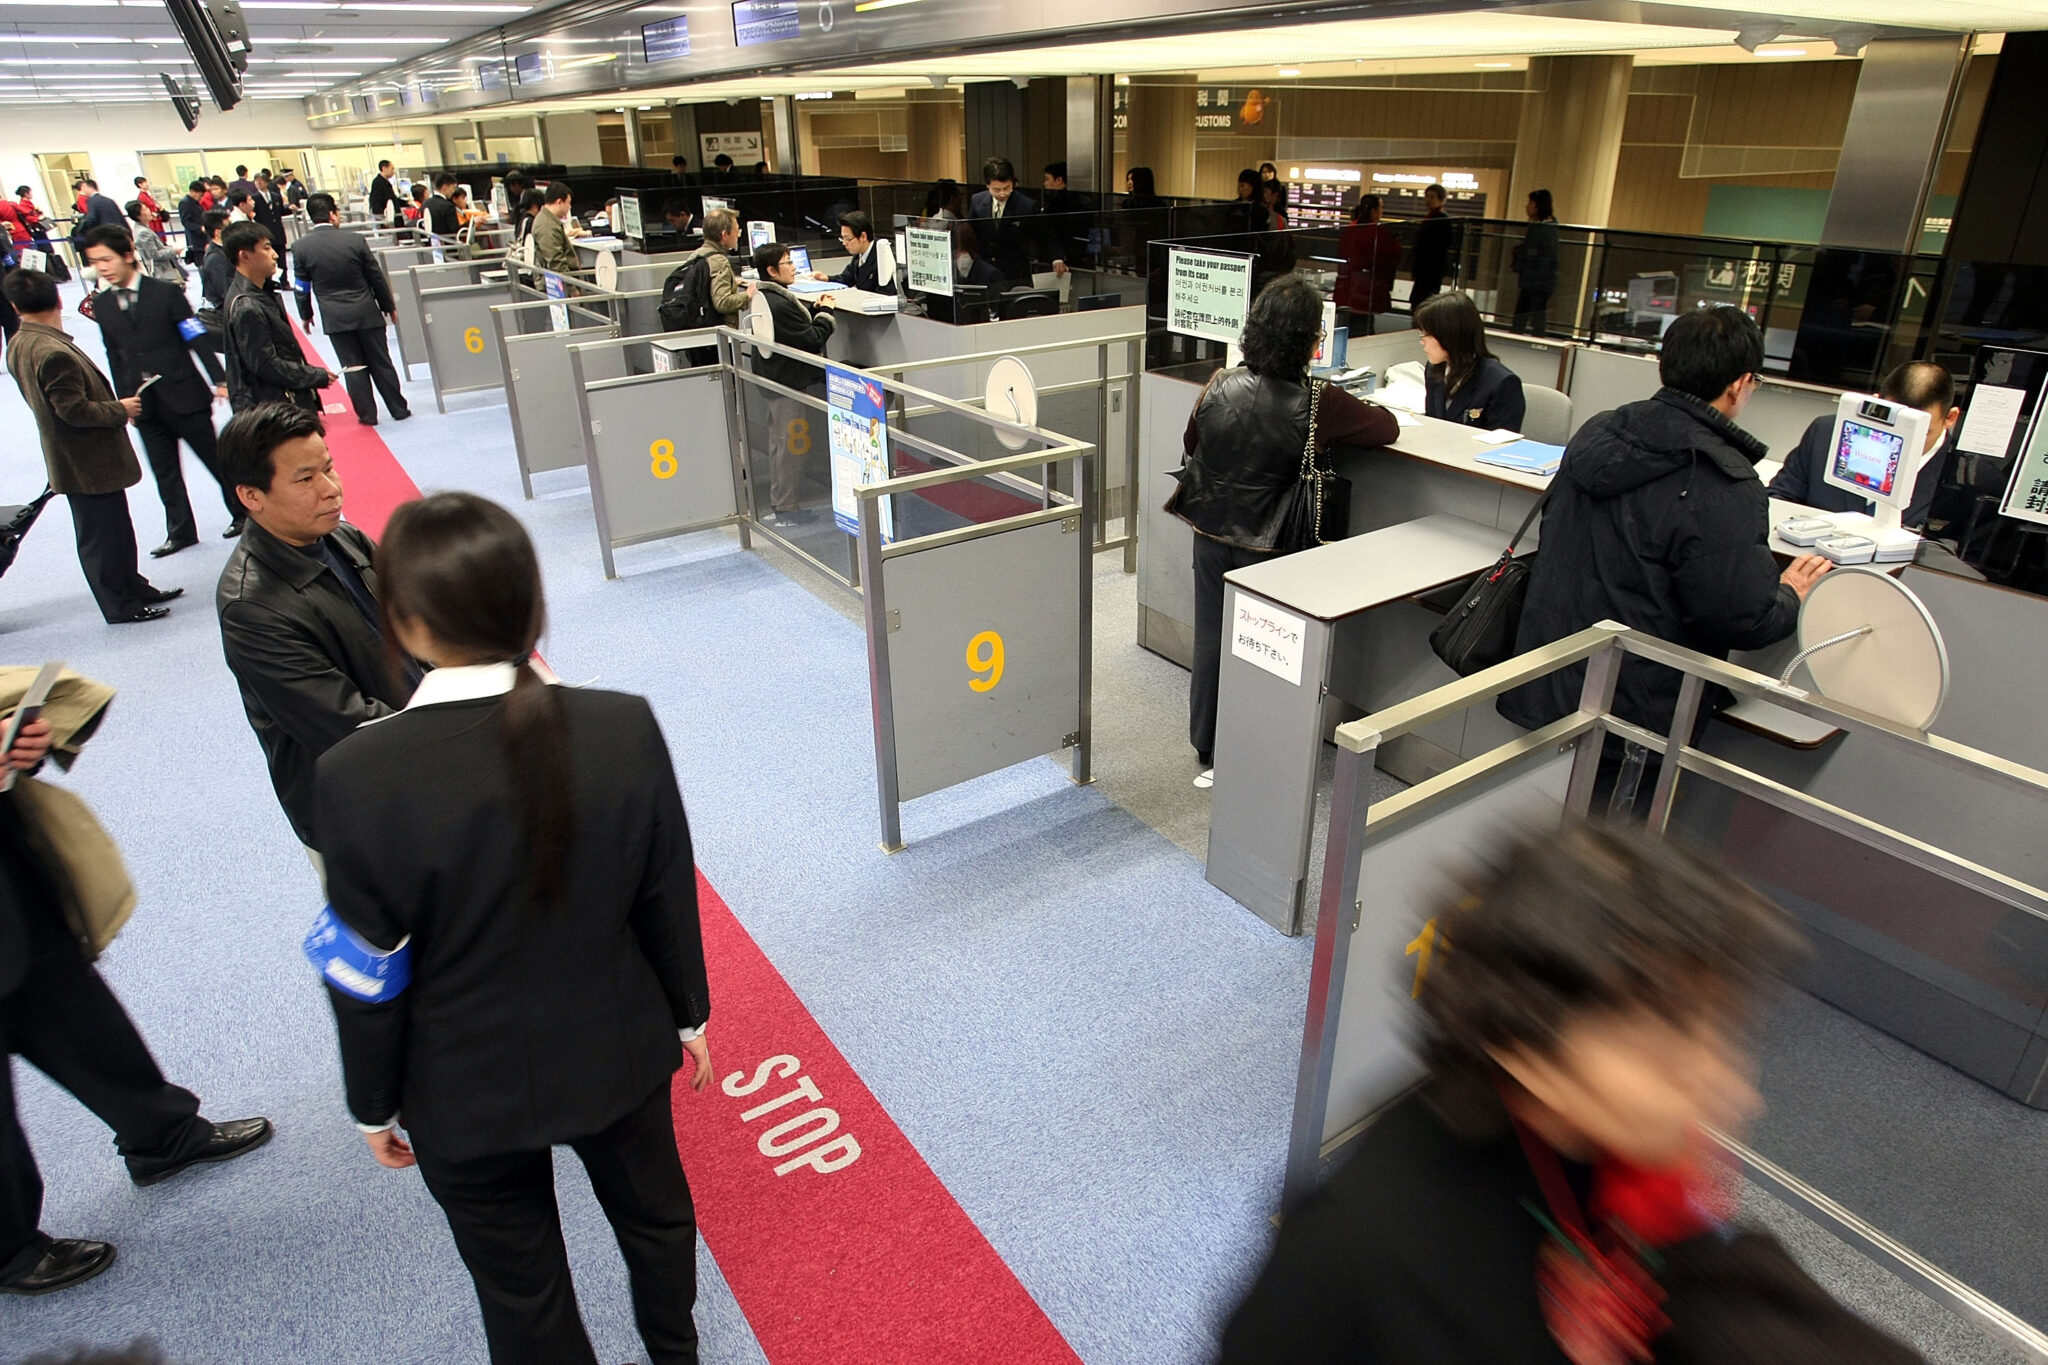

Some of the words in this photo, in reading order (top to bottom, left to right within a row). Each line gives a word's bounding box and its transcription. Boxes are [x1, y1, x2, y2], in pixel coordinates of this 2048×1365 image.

[1175, 255, 1194, 266] Please
[1194, 258, 1206, 267] take
[1206, 260, 1220, 270] your
[1220, 262, 1246, 273] passport
[1175, 268, 1187, 277] from
[1195, 271, 1209, 280] case
[1175, 279, 1193, 290] 여권과
[1230, 286, 1244, 298] 분리
[1175, 292, 1199, 304] 해주세요
[464, 327, 484, 353] 6
[649, 439, 678, 479] 8
[1239, 608, 1298, 644] ストップラインで
[965, 630, 1005, 693] 9
[721, 1053, 862, 1177] STOP
